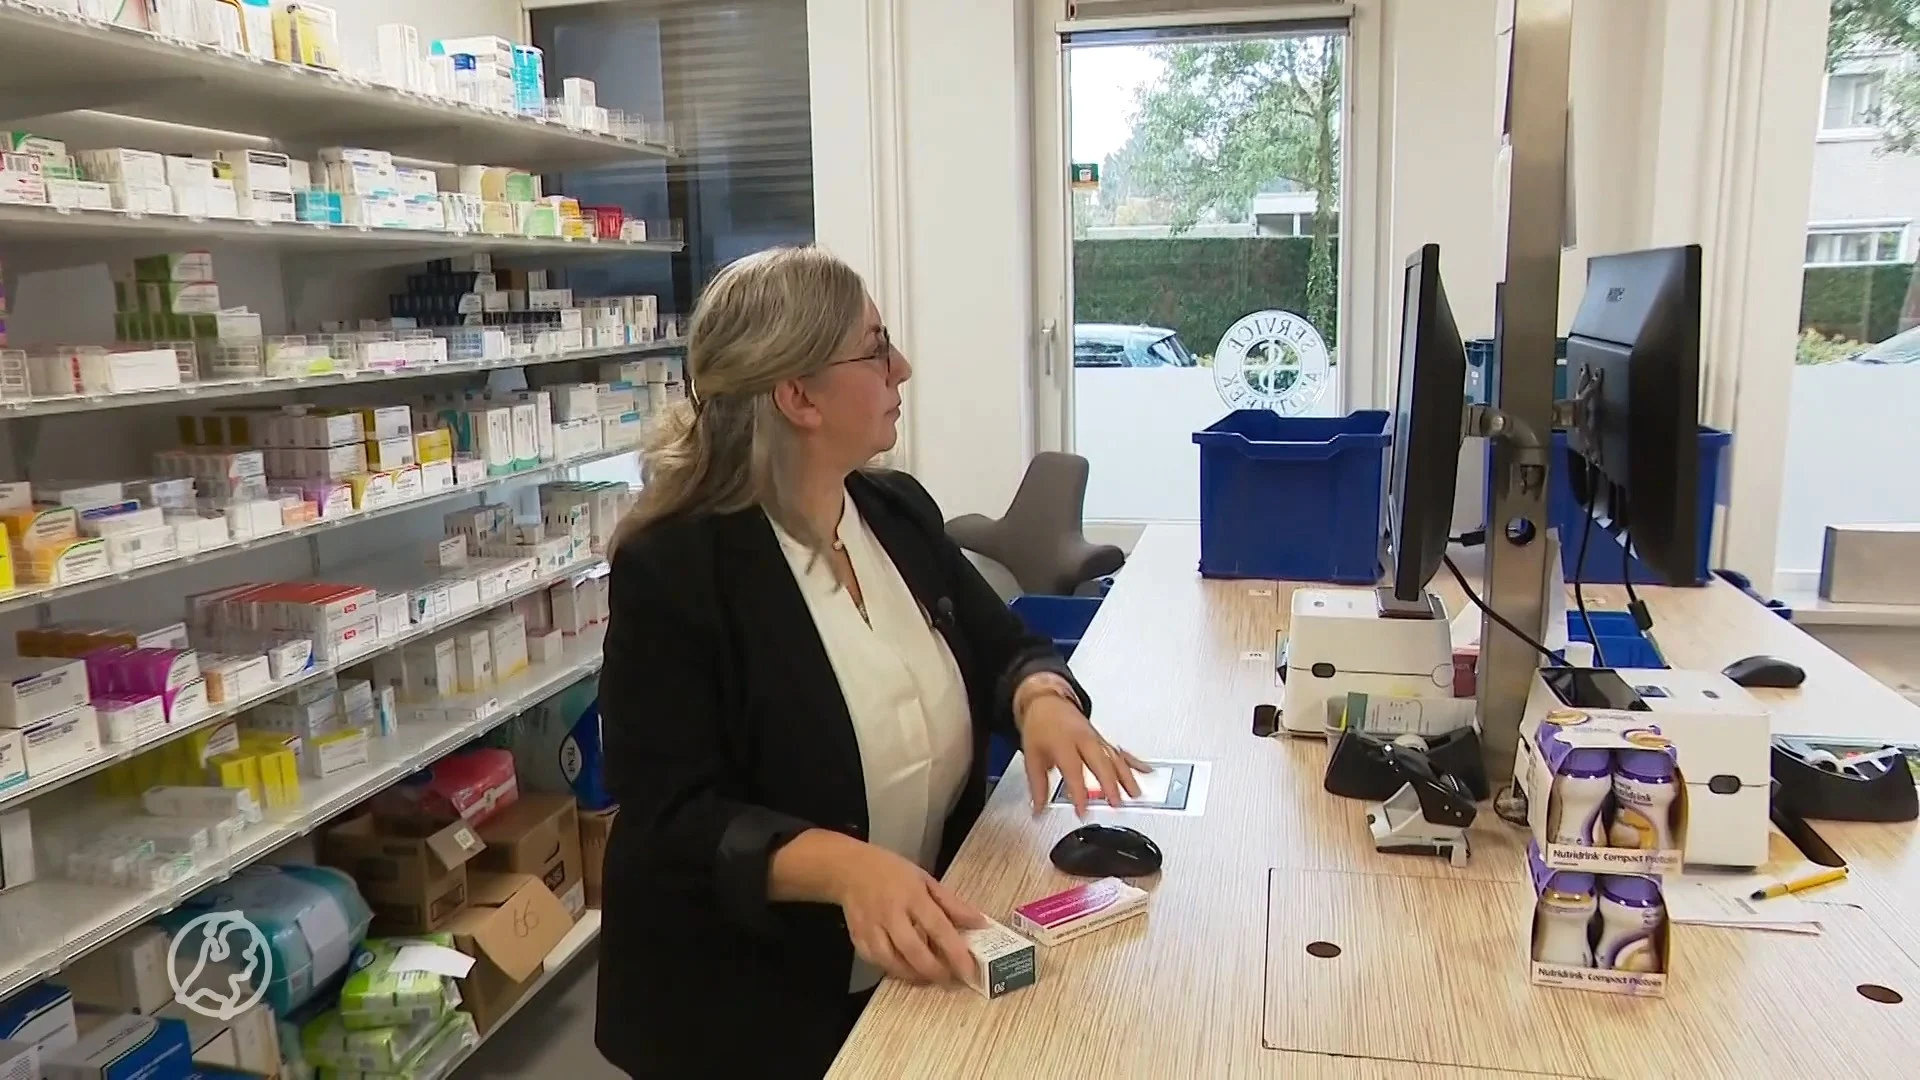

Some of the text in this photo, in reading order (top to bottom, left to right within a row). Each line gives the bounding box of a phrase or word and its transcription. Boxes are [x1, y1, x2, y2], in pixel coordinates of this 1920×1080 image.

[1553, 849, 1599, 860] Nutridrink
[1603, 853, 1643, 863] Compact
[1538, 967, 1584, 979] Nutridrink
[1588, 973, 1627, 984] Compact
